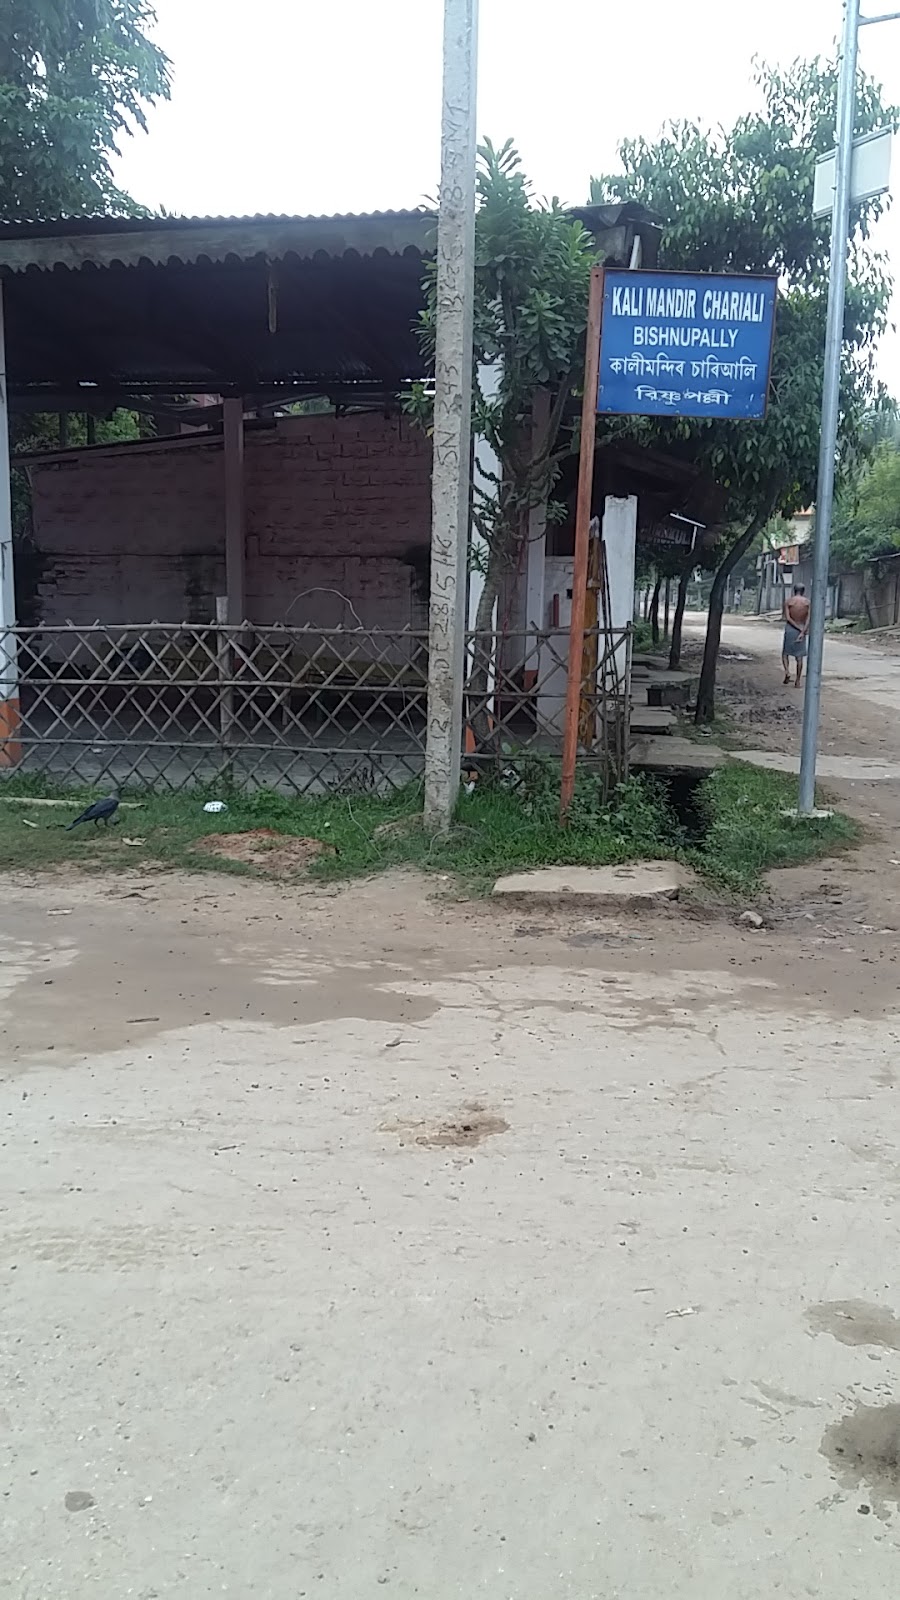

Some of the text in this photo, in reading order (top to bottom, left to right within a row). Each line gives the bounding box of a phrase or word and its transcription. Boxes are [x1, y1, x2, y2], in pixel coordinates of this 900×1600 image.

[612, 286, 765, 322] KALI MANDIR CHARIALI
[633, 326, 739, 348] BISHNUPALLY
[690, 354, 758, 380] চাৰিআলি
